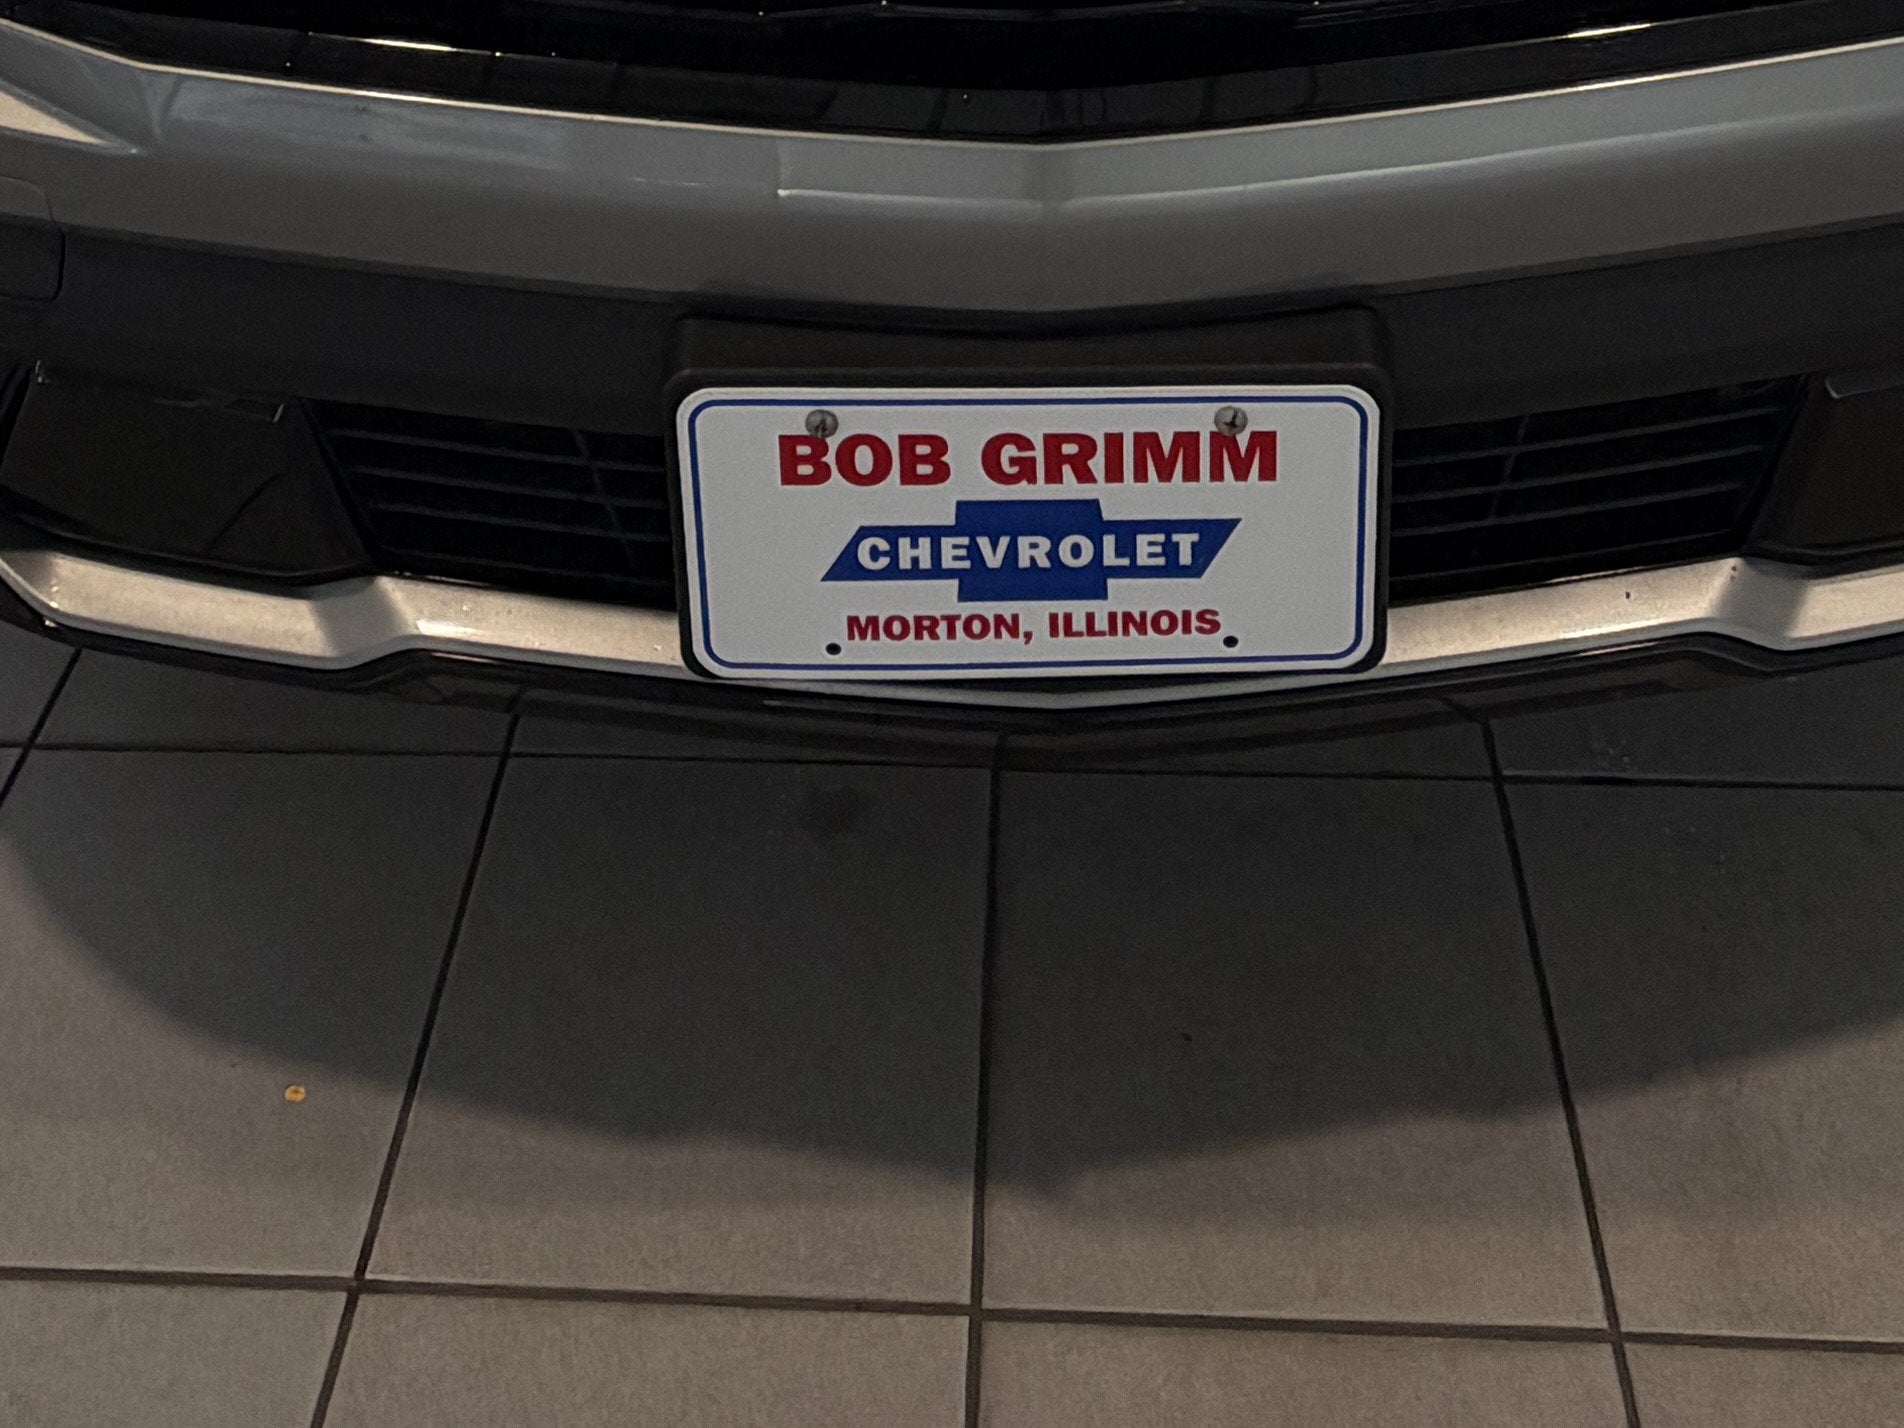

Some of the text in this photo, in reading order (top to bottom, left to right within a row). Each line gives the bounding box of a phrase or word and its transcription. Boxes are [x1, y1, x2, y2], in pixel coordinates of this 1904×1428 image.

[778, 430, 1278, 486] BOB GRIMM
[856, 532, 1200, 571] CHEVROLET
[846, 609, 1222, 645] MORTON, ILLINOIS
